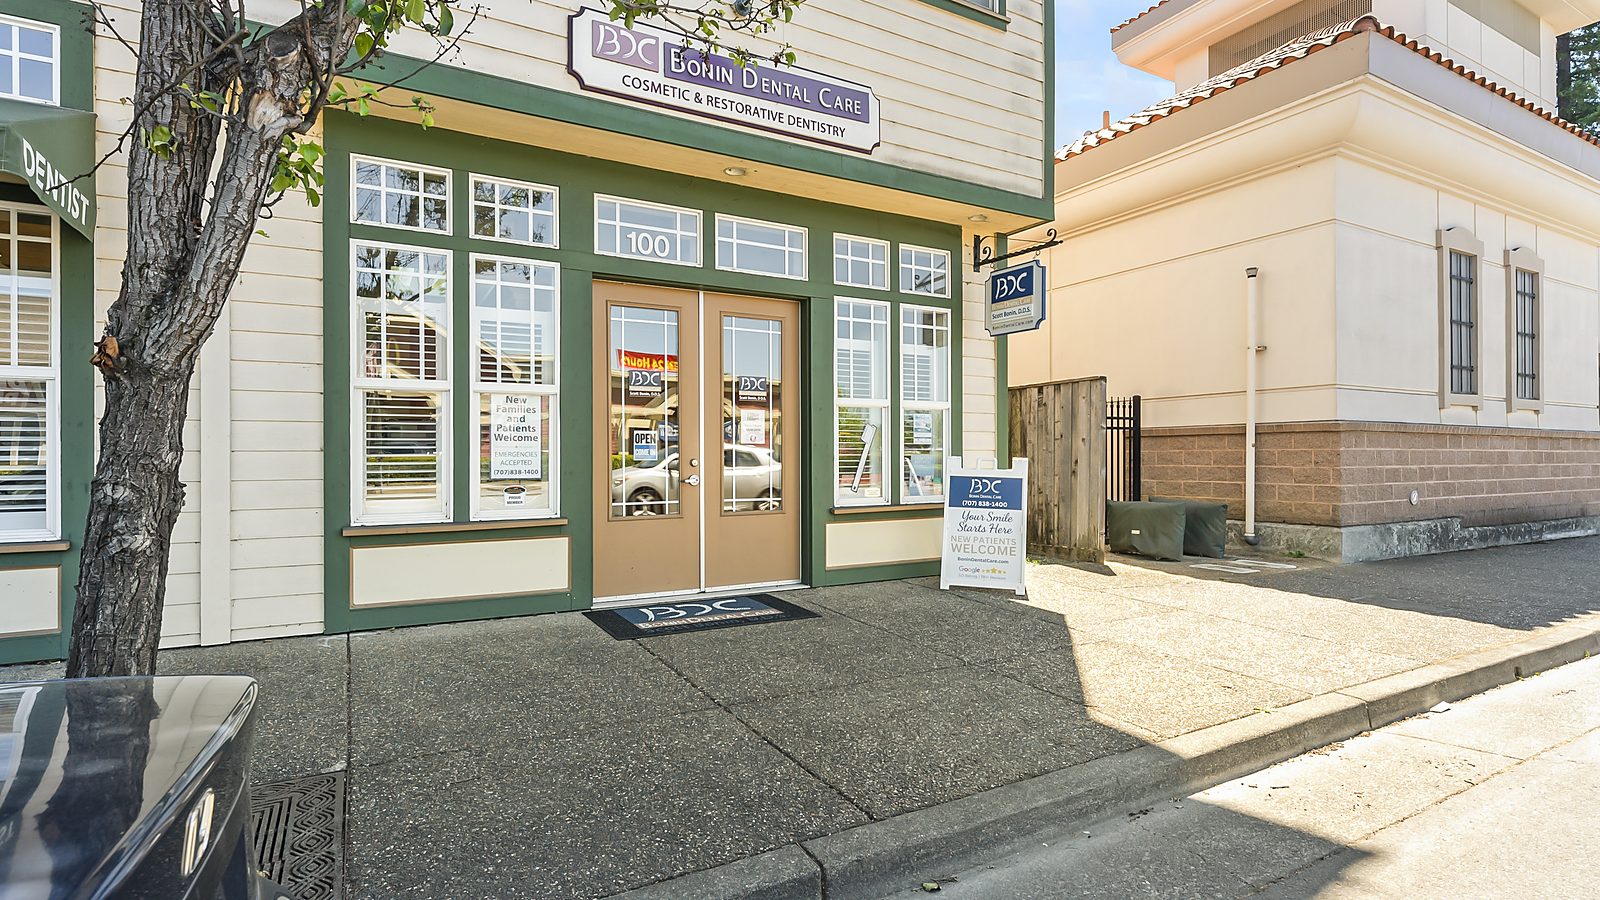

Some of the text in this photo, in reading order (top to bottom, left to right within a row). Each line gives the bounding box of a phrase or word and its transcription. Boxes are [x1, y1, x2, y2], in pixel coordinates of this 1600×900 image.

[622, 74, 846, 138] COSMETIC & RESTORATIVE DENTISTRY
[22, 137, 90, 226] DENTIST
[626, 231, 670, 257] 100
[992, 312, 1003, 320] Scott
[505, 395, 528, 404] New
[496, 406, 537, 414] Families
[506, 414, 526, 423] and
[496, 424, 537, 433] Patients
[493, 433, 539, 442] Welcome
[635, 433, 656, 444] OPEN
[978, 500, 1008, 508] 838-1400
[961, 510, 1013, 523] Your Smile
[957, 521, 1014, 535] Starts Here
[950, 535, 1017, 545] NEW PATIENTS
[951, 543, 1017, 557] WELCOME
[958, 565, 981, 574] Google
